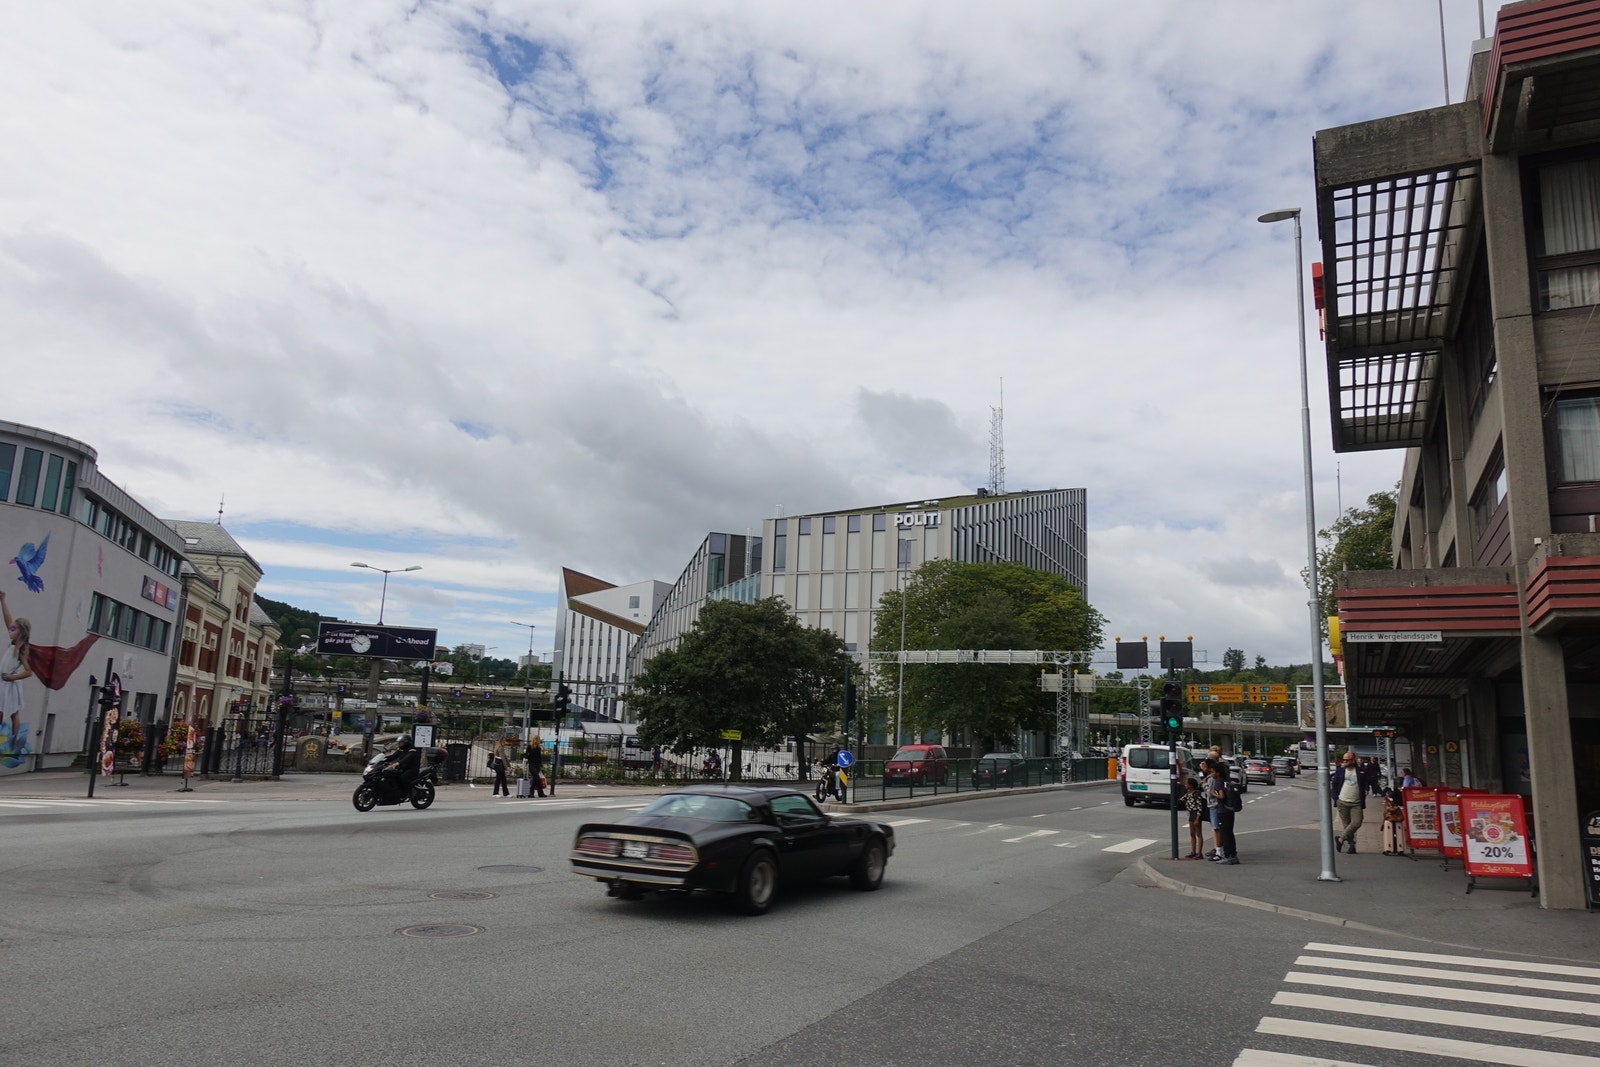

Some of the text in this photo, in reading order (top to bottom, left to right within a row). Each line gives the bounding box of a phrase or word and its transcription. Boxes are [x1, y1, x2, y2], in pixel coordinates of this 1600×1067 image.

[894, 513, 941, 527] POLITI
[1377, 632, 1438, 641] Wergelandsgate
[1480, 846, 1514, 858] -20%
